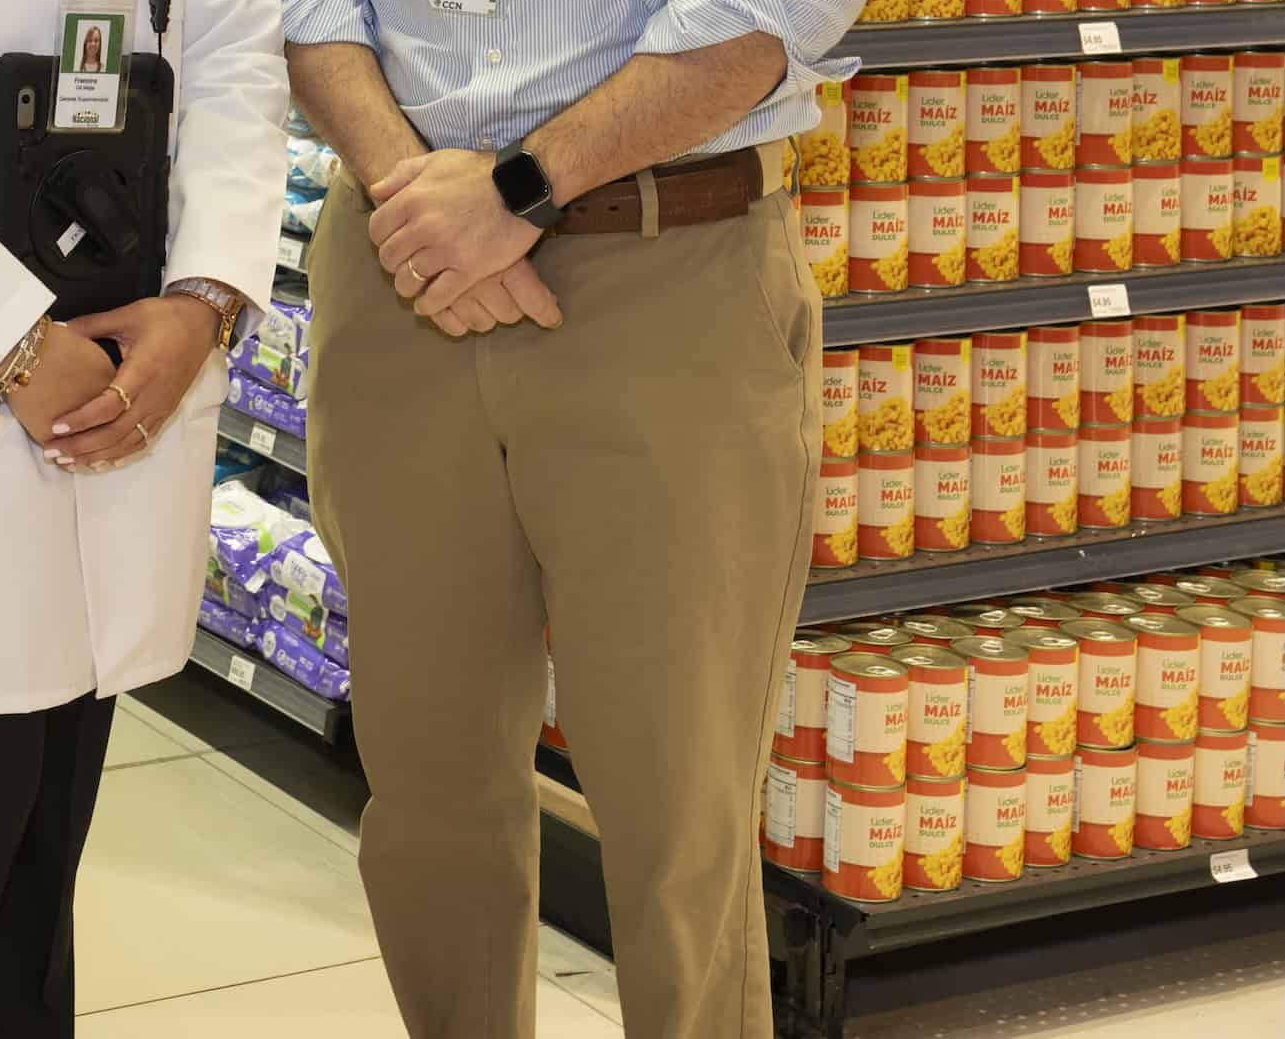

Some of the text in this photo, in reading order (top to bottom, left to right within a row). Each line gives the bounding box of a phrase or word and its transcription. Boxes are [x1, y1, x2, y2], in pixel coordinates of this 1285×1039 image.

[442, 1, 463, 10] CCN
[1191, 87, 1227, 102] MAÍZ
[920, 104, 957, 119] MAÍZ
[981, 102, 1015, 116] MAÍZ
[1035, 98, 1069, 113] MAÍZ
[853, 108, 891, 123] MAÍZ
[973, 208, 1010, 224] MAÍZ
[804, 223, 841, 238] MAÍZ
[872, 219, 905, 234] MAÍZ
[1252, 335, 1283, 350] MAÍZ
[1137, 345, 1174, 361] MAÍZ
[918, 371, 956, 387] MAÍZ
[1201, 445, 1234, 458] MAÍZ
[1241, 438, 1275, 451] MAÍZ
[1096, 674, 1131, 689] MAÍZ
[1161, 668, 1196, 683] MAÍZ
[1036, 682, 1073, 697] MAÍZ
[924, 705, 960, 719] MAÍZ
[920, 816, 957, 830] MAÍZ
[869, 826, 903, 841] MAÍZ
